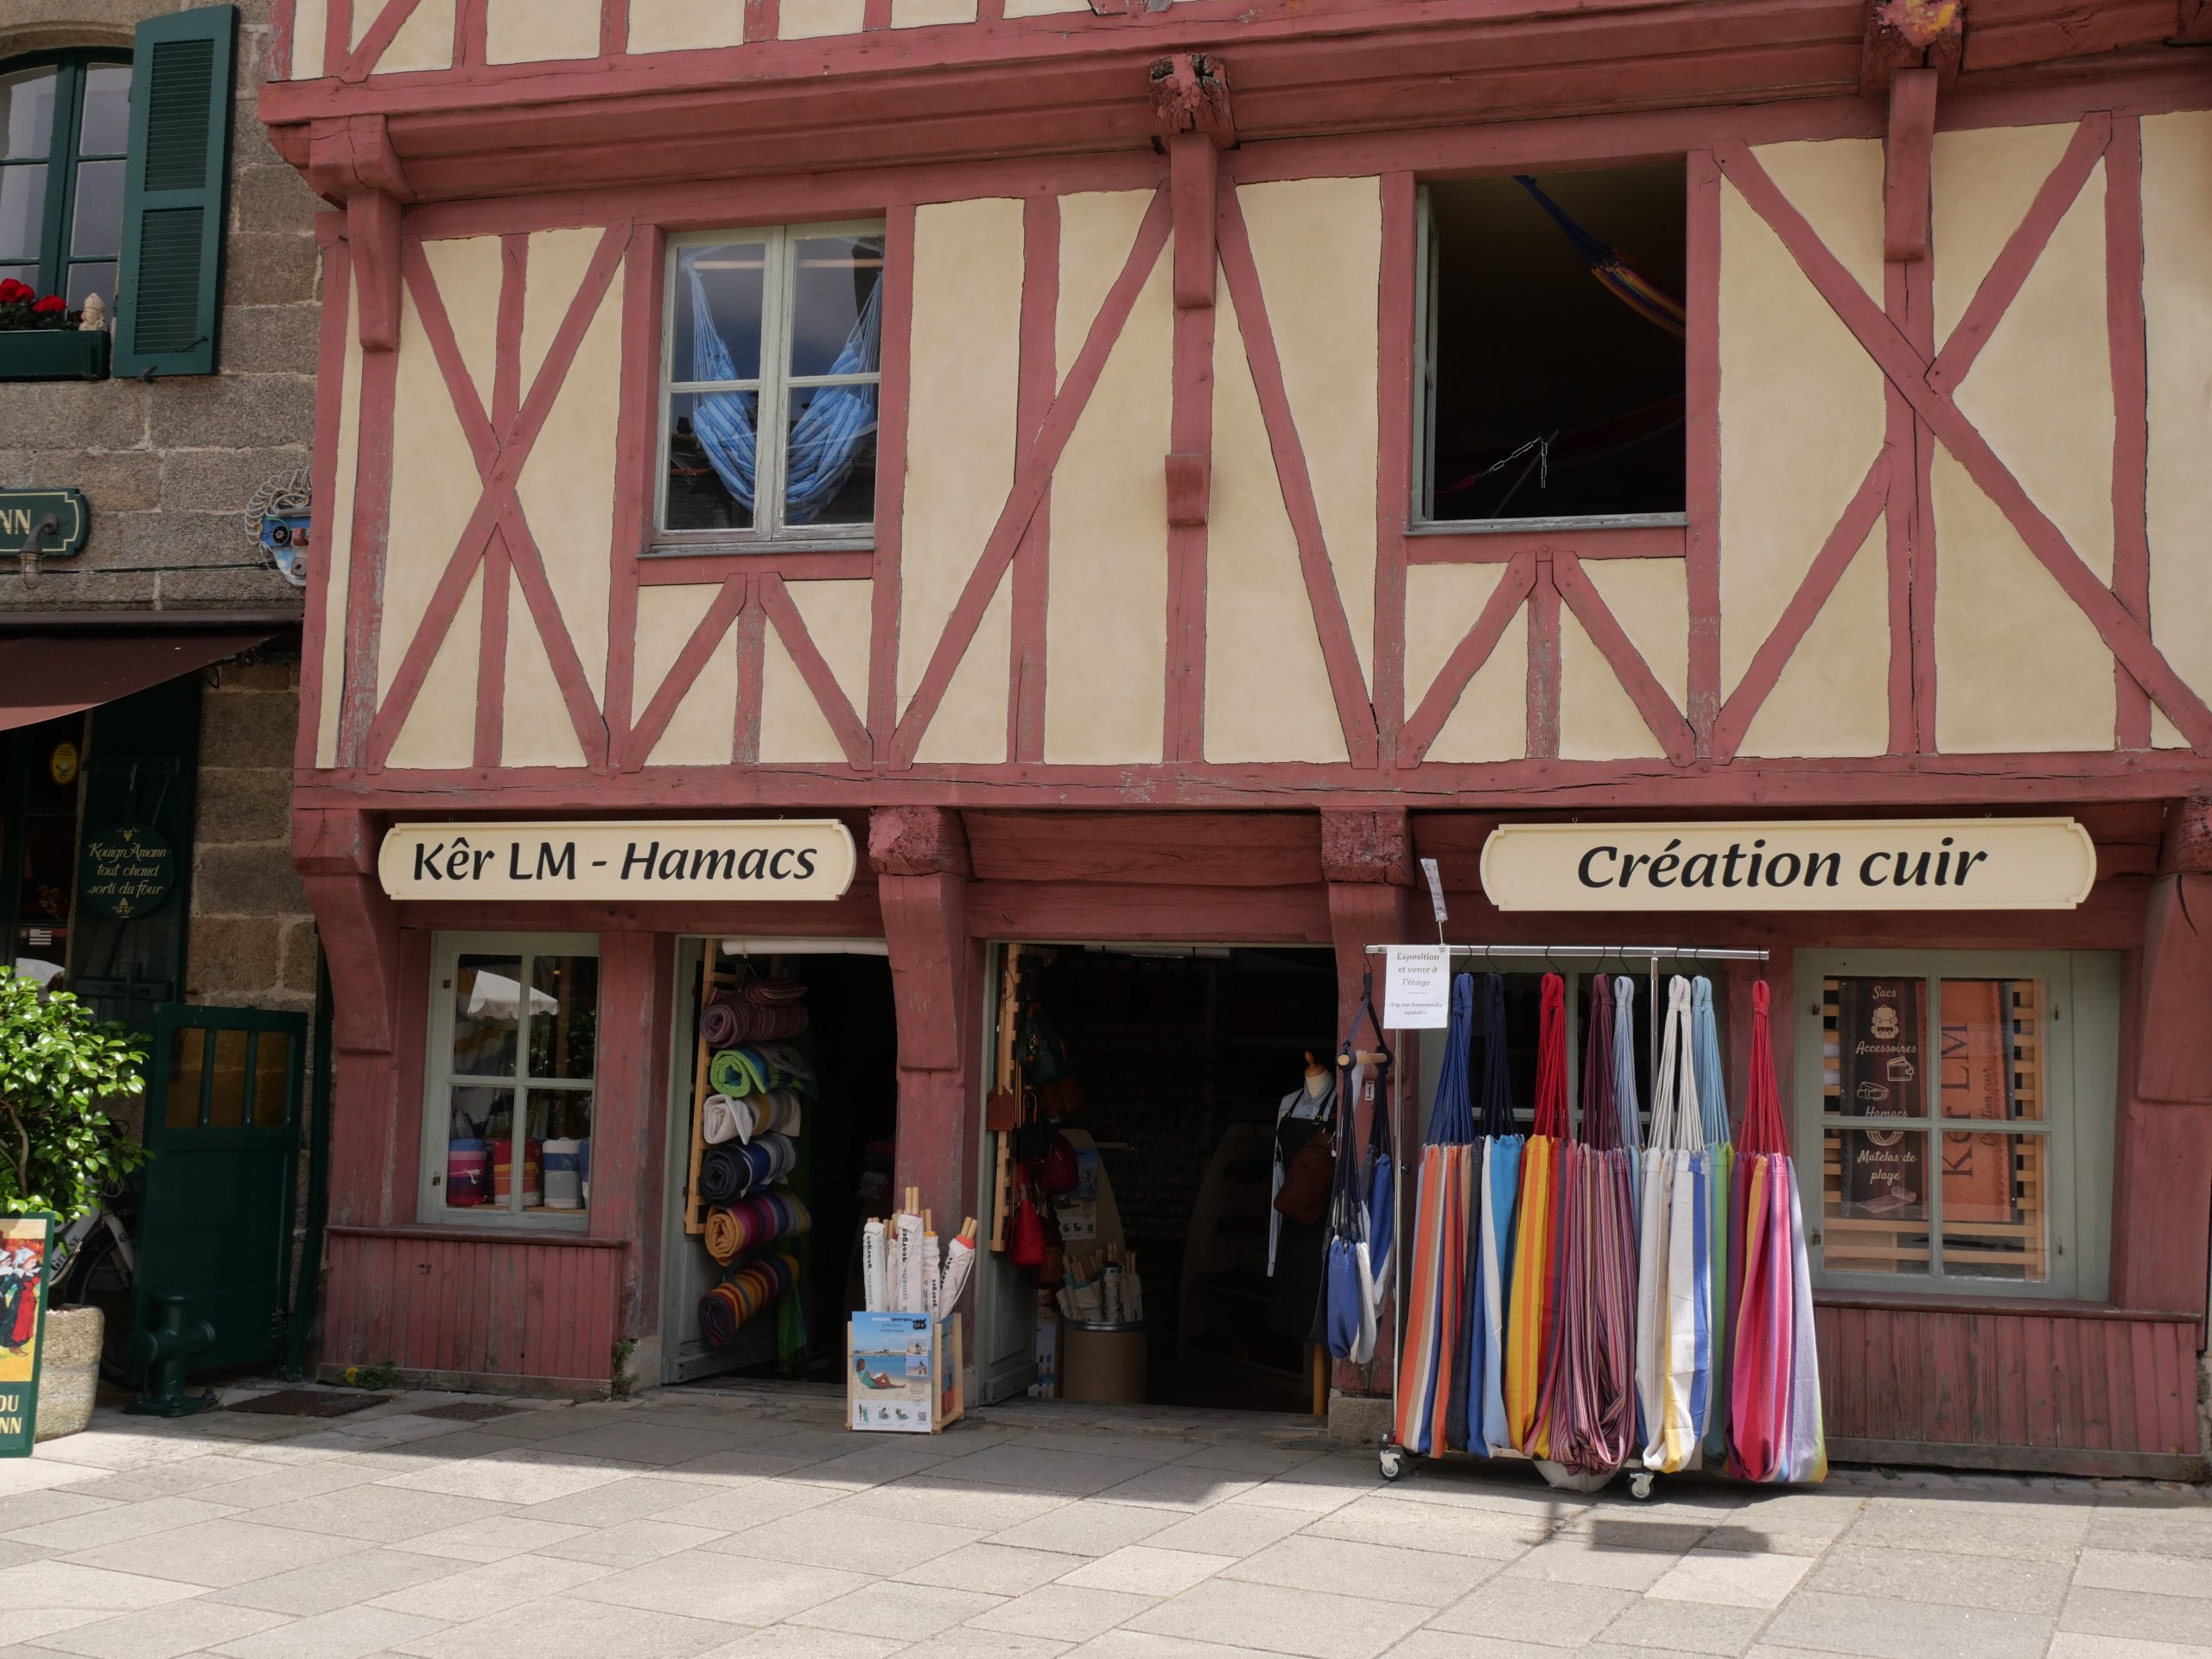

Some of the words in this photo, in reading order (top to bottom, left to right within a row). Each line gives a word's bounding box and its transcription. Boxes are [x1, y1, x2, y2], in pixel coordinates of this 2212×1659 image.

[414, 837, 494, 880] Kêr
[510, 842, 575, 880] LM
[621, 842, 817, 880] Hamacs
[1579, 839, 1840, 887] Création
[1860, 837, 1987, 886] cuir
[97, 864, 121, 876] tout
[123, 864, 160, 876] chaud
[88, 881, 117, 894] sorti
[119, 881, 135, 894] du
[136, 880, 163, 898] four
[1396, 952, 1440, 962] Exposition
[1402, 978, 1431, 988] l'étage
[1872, 986, 1897, 999] Sacs
[1855, 1040, 1916, 1055] Accessoires
[1865, 1106, 1908, 1118] Hamacs
[1857, 1150, 1899, 1163] Matelas
[1902, 1151, 1916, 1162] de
[1869, 1168, 1902, 1186] plage
